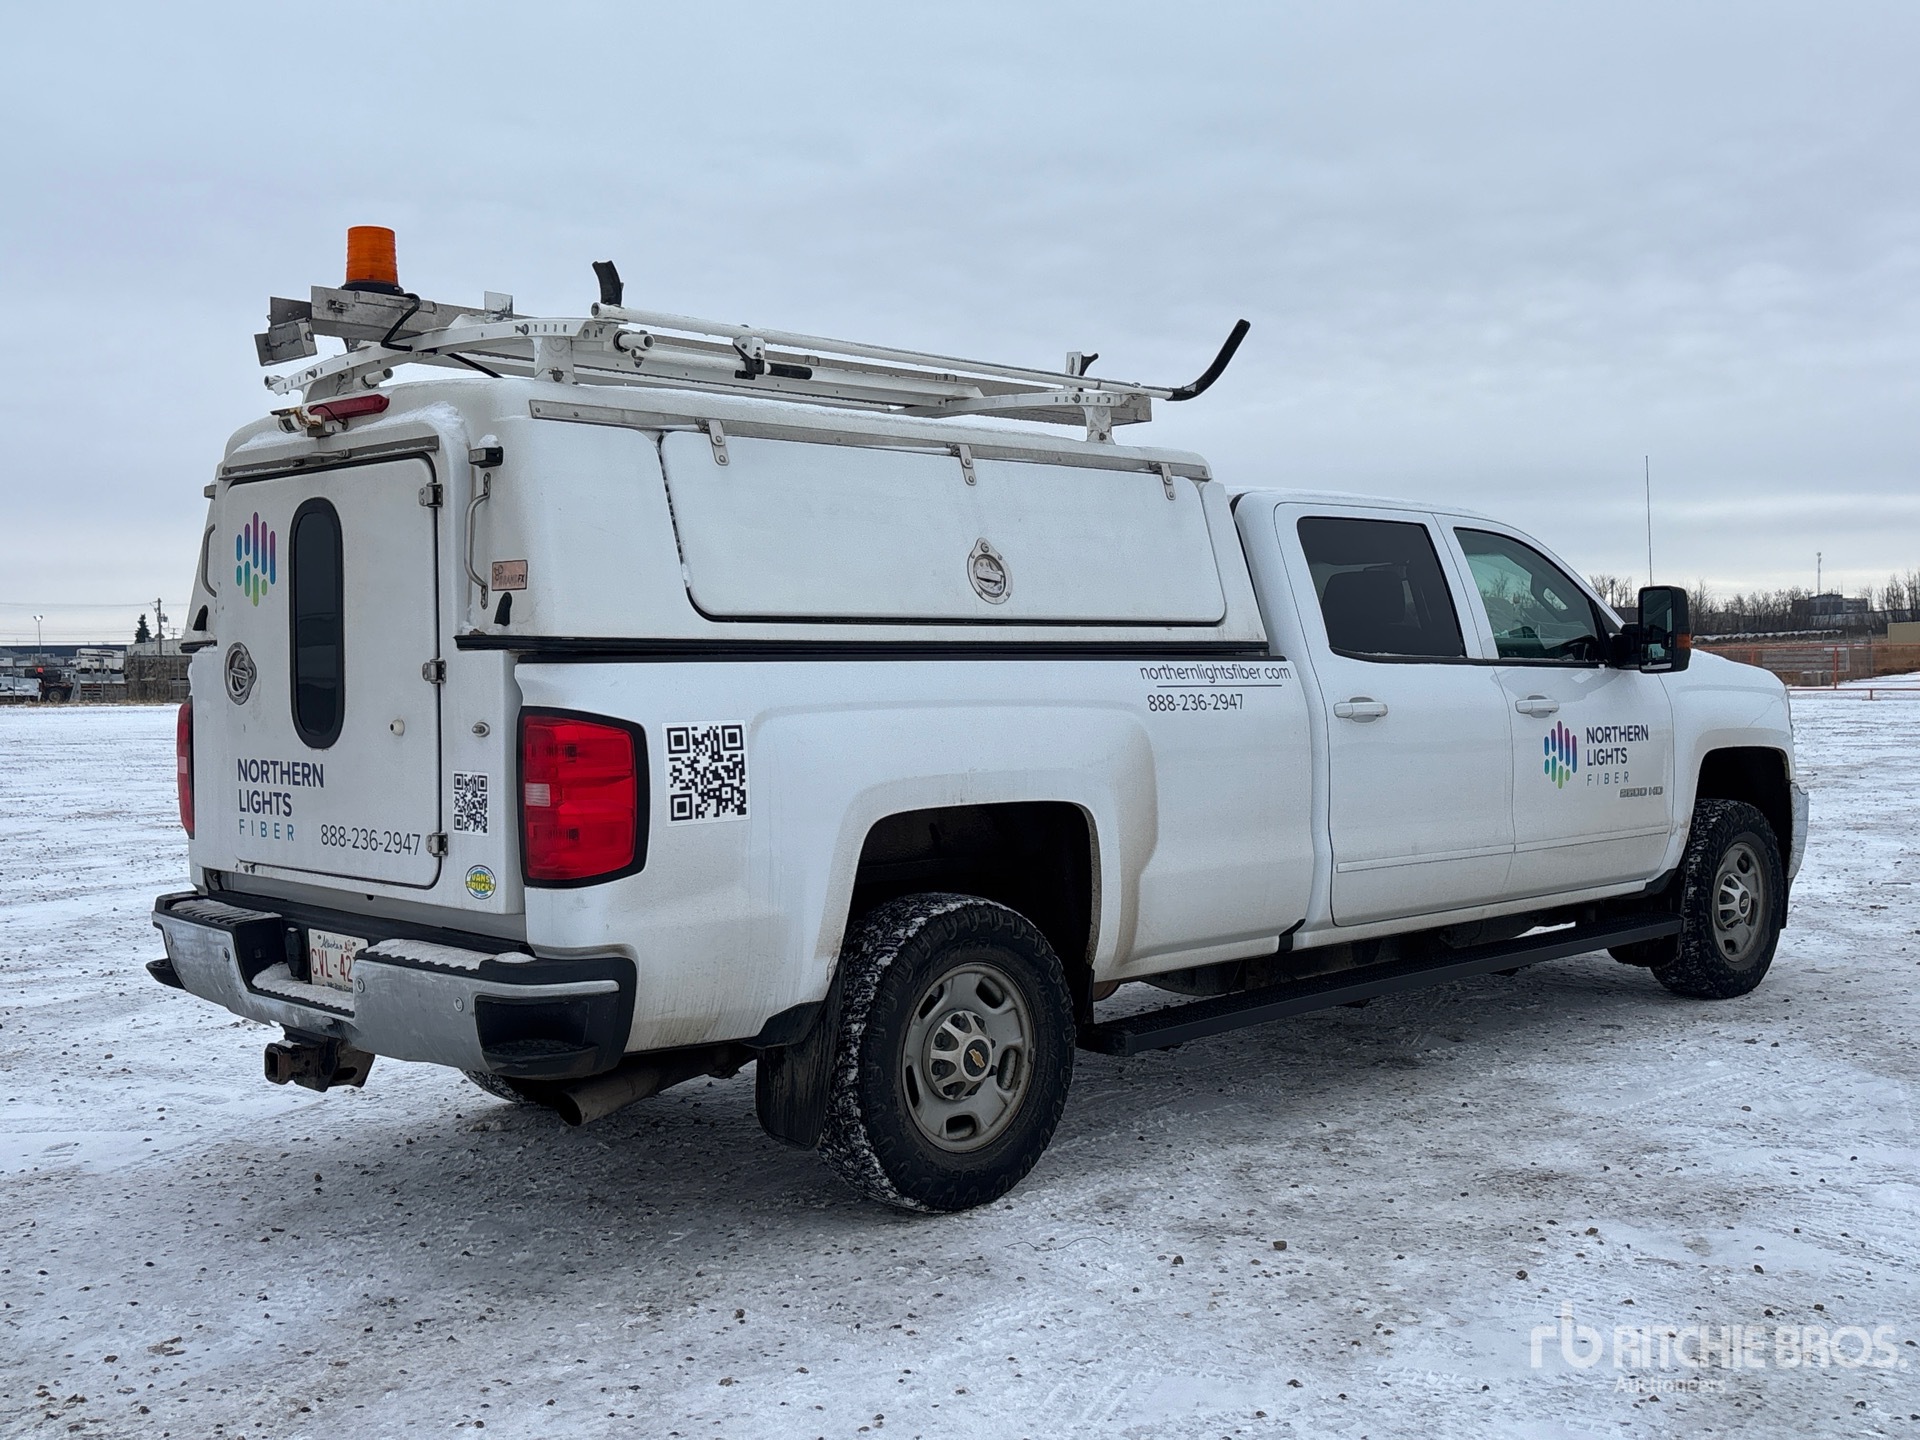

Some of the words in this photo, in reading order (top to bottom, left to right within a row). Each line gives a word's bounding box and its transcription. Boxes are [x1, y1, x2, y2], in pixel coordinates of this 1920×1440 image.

[1147, 693, 1243, 712] 888-236-2947
[1586, 724, 1649, 744] NORTHERN
[1587, 747, 1628, 766] LIGHTS
[237, 758, 324, 788] NORTHERN
[1586, 771, 1630, 786] FIBER
[238, 789, 293, 817] LIGHTS
[238, 818, 295, 841] FIBER
[320, 824, 421, 856] 888-236-2947
